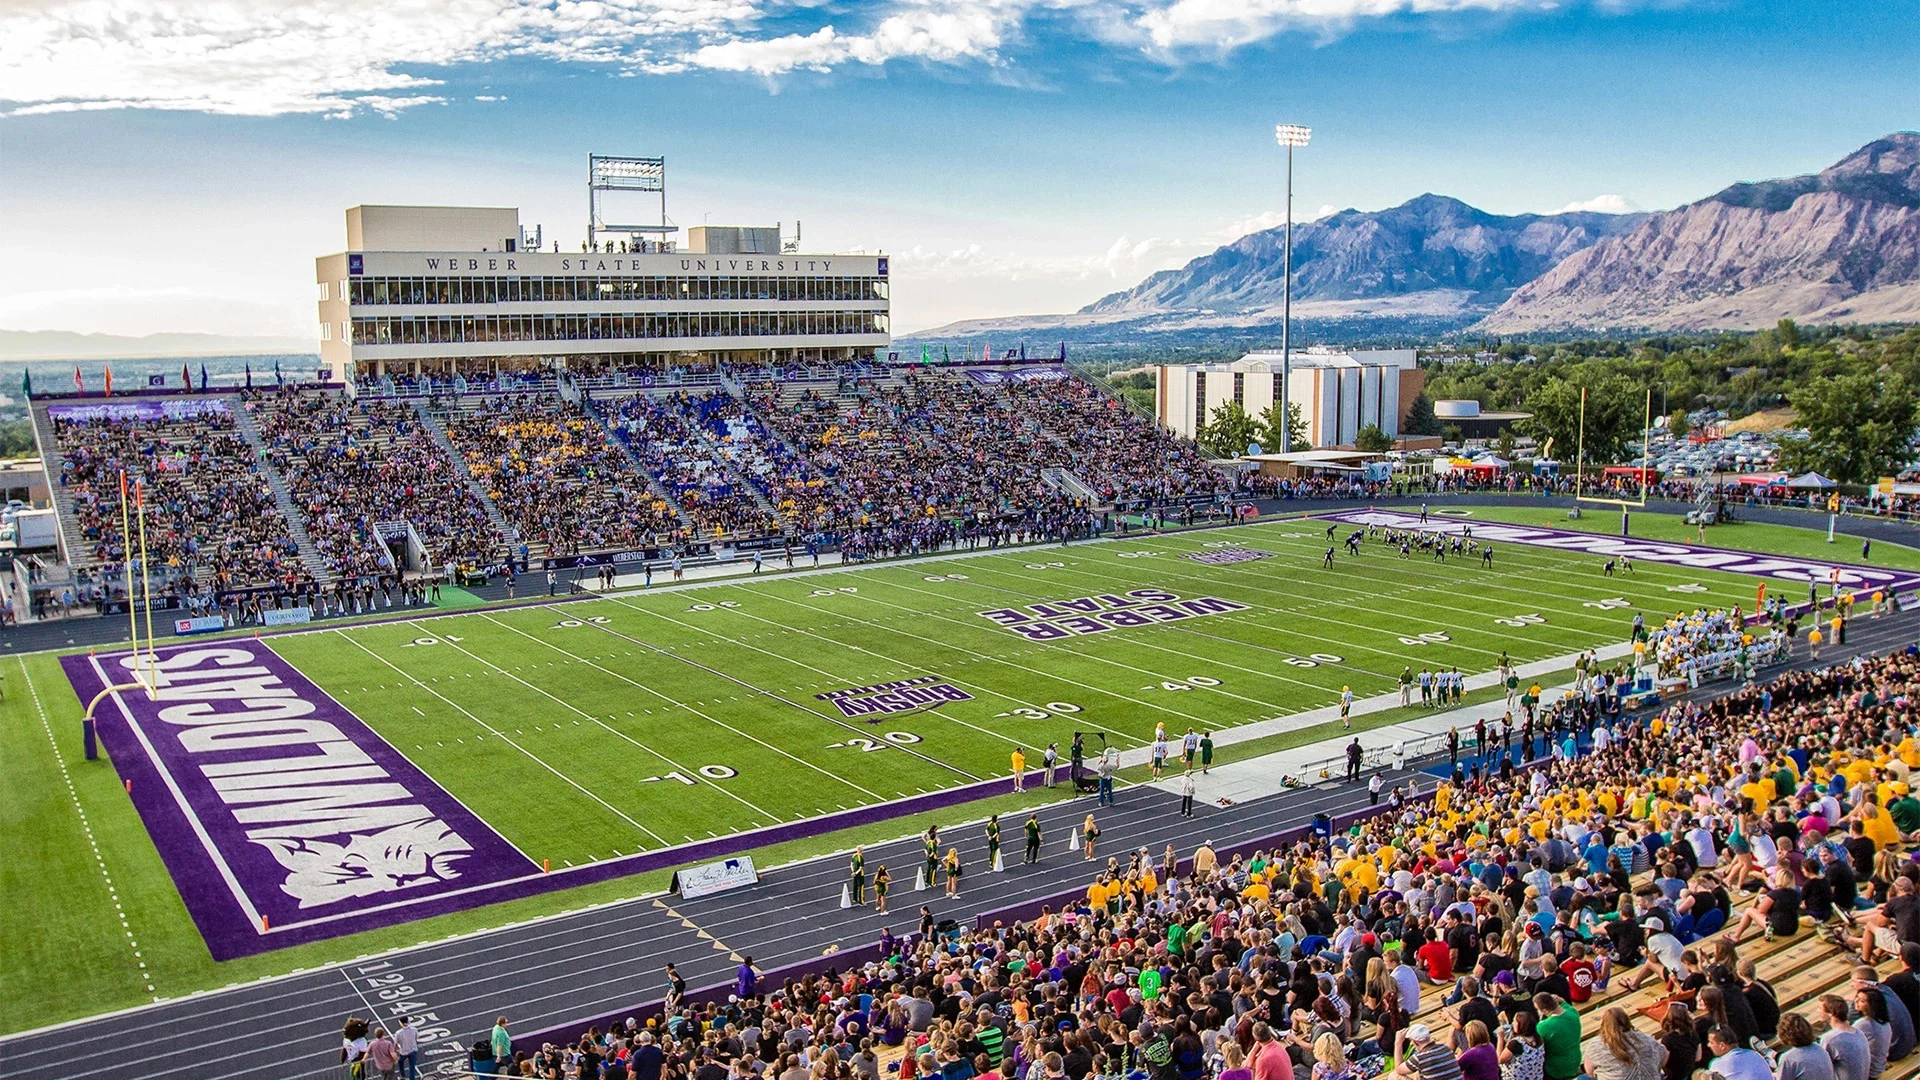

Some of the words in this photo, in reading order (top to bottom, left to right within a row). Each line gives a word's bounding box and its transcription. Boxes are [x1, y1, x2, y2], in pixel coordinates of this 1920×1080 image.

[427, 258, 517, 271] WEBER
[562, 258, 641, 271] STATE
[681, 259, 832, 272] UNIVERSITY
[152, 377, 161, 385] G
[644, 376, 652, 385] D
[691, 601, 741, 612] 30
[976, 589, 1181, 626] STATE
[558, 616, 611, 628] 20
[1004, 596, 1252, 641] WEBER
[413, 635, 464, 645] 10
[1398, 631, 1452, 645] 40
[1282, 653, 1346, 668] 50
[1161, 676, 1224, 691] 40
[1012, 701, 1085, 720] 30
[847, 731, 924, 752] 20
[119, 648, 475, 852] WILDCATS
[663, 765, 739, 785] 10
[357, 961, 394, 975] 1
[366, 973, 404, 988] 2
[1146, 977, 1154, 990] 3
[378, 985, 415, 1000] 3
[389, 1001, 428, 1015] 4
[406, 1012, 440, 1027] 5
[416, 1027, 451, 1043] 6
